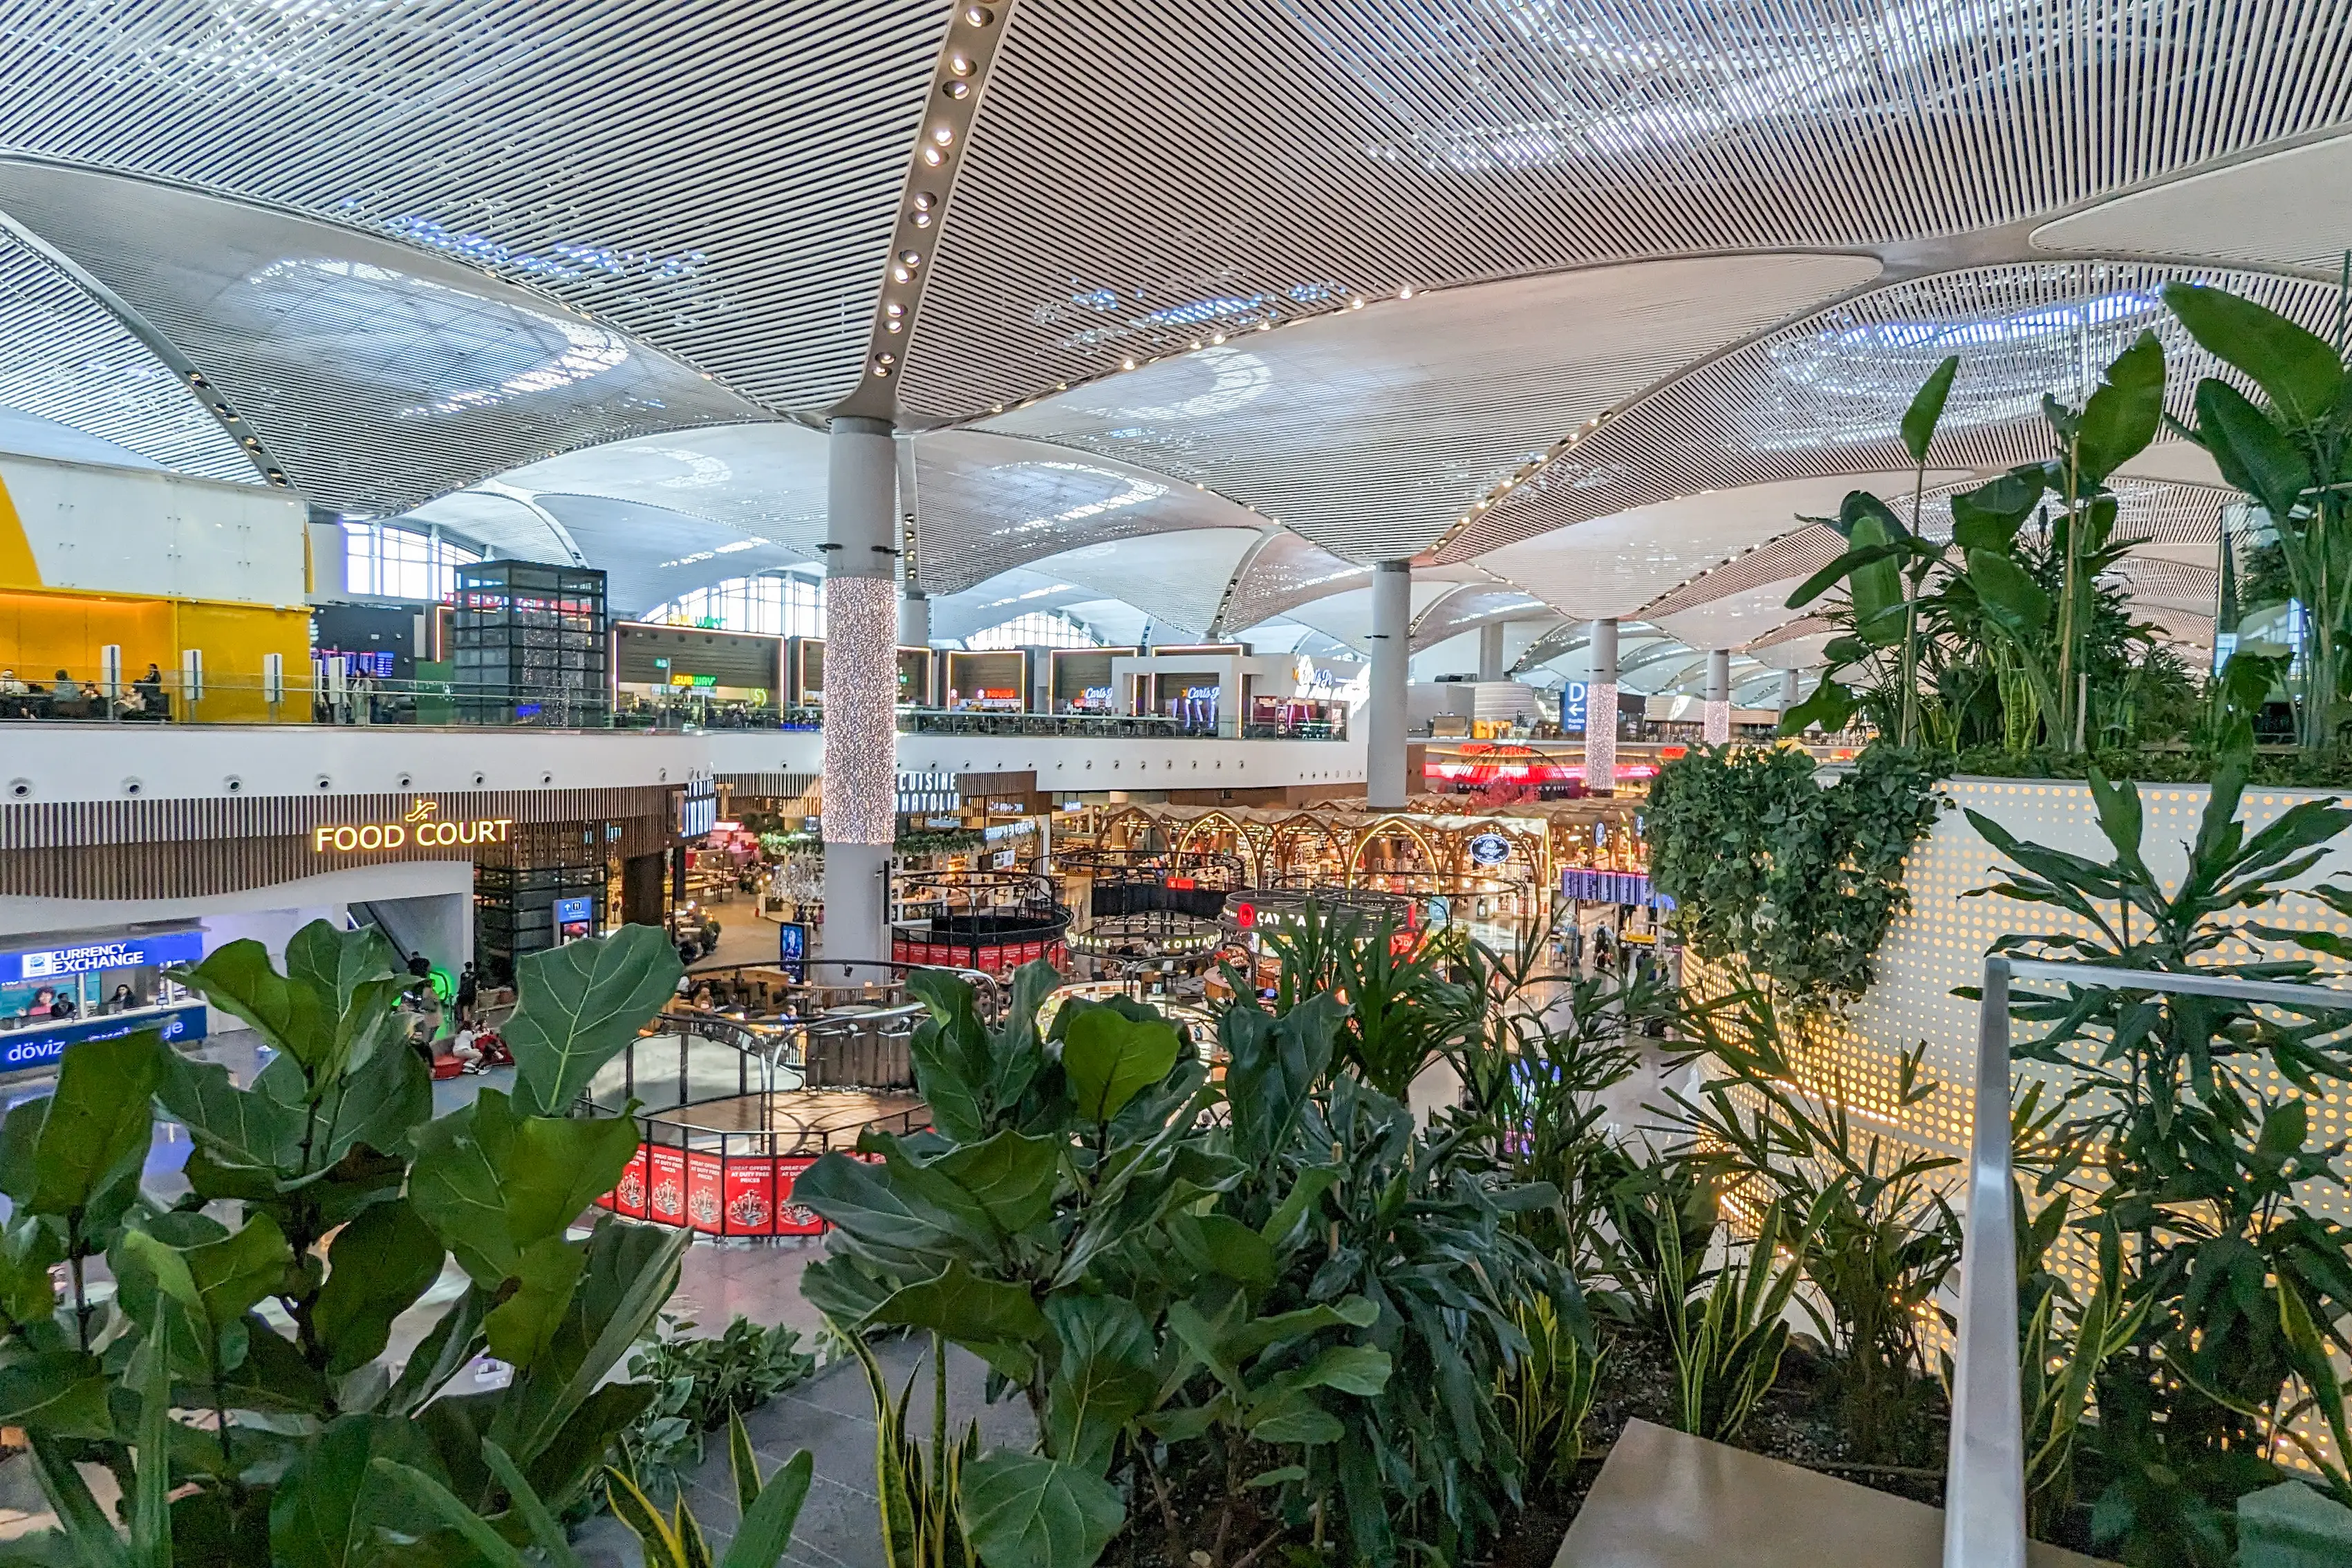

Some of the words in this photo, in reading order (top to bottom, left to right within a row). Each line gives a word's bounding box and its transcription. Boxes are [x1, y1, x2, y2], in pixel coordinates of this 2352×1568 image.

[673, 675, 716, 686] SUBWAY
[1085, 687, 1106, 698] Carl's
[1188, 687, 1210, 700] Carl's
[1569, 682, 1585, 702] D
[899, 773, 956, 792] CUISINE
[316, 825, 405, 852] FOOD
[416, 819, 512, 846] COURT
[1256, 911, 1280, 927] ÇAY
[1079, 935, 1111, 948] SAAT
[52, 943, 127, 962] CURRENCY
[52, 951, 144, 974] EXCHANGE
[8, 1040, 66, 1062] döviz
